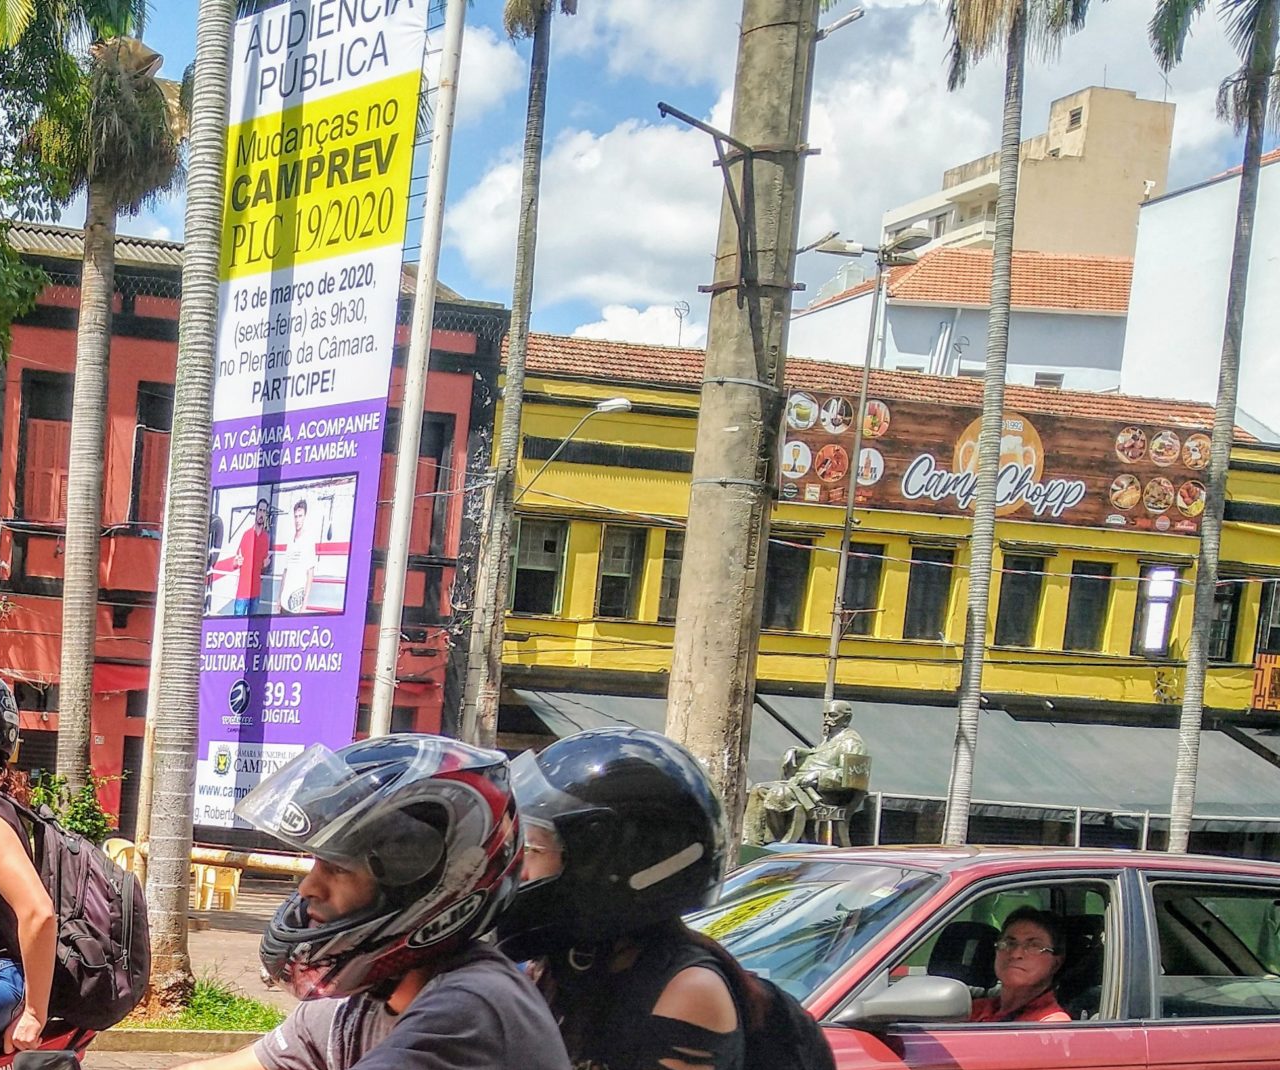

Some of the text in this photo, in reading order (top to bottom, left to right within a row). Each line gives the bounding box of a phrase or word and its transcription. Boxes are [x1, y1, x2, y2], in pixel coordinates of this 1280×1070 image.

[259, 31, 389, 105] PÚBLICA
[236, 98, 399, 168] Mudanças no
[231, 133, 399, 212] CAMPREV
[229, 186, 395, 268] PLC 19/2020
[233, 262, 377, 312] 13 de março de 2020,
[234, 297, 368, 349] (sexta-feira) às 9h30,
[219, 333, 378, 377] no Plenário da Câmara.
[252, 368, 336, 403] PARTICIPE!
[224, 431, 238, 449] TV
[239, 424, 295, 447] CÂMARA,
[296, 412, 381, 441] ACOMPANHE
[218, 436, 359, 472] A AUDIÊNCIA E TAMBÉM:
[995, 463, 1085, 514] Chopp
[205, 626, 335, 652] ESPORTES, NUTRIÇÃO,
[200, 652, 342, 673] CULTURA, E MUITO MAIS!
[261, 708, 301, 724] DIGITAL
[263, 681, 302, 708] 39.3
[421, 895, 480, 942] HJC
